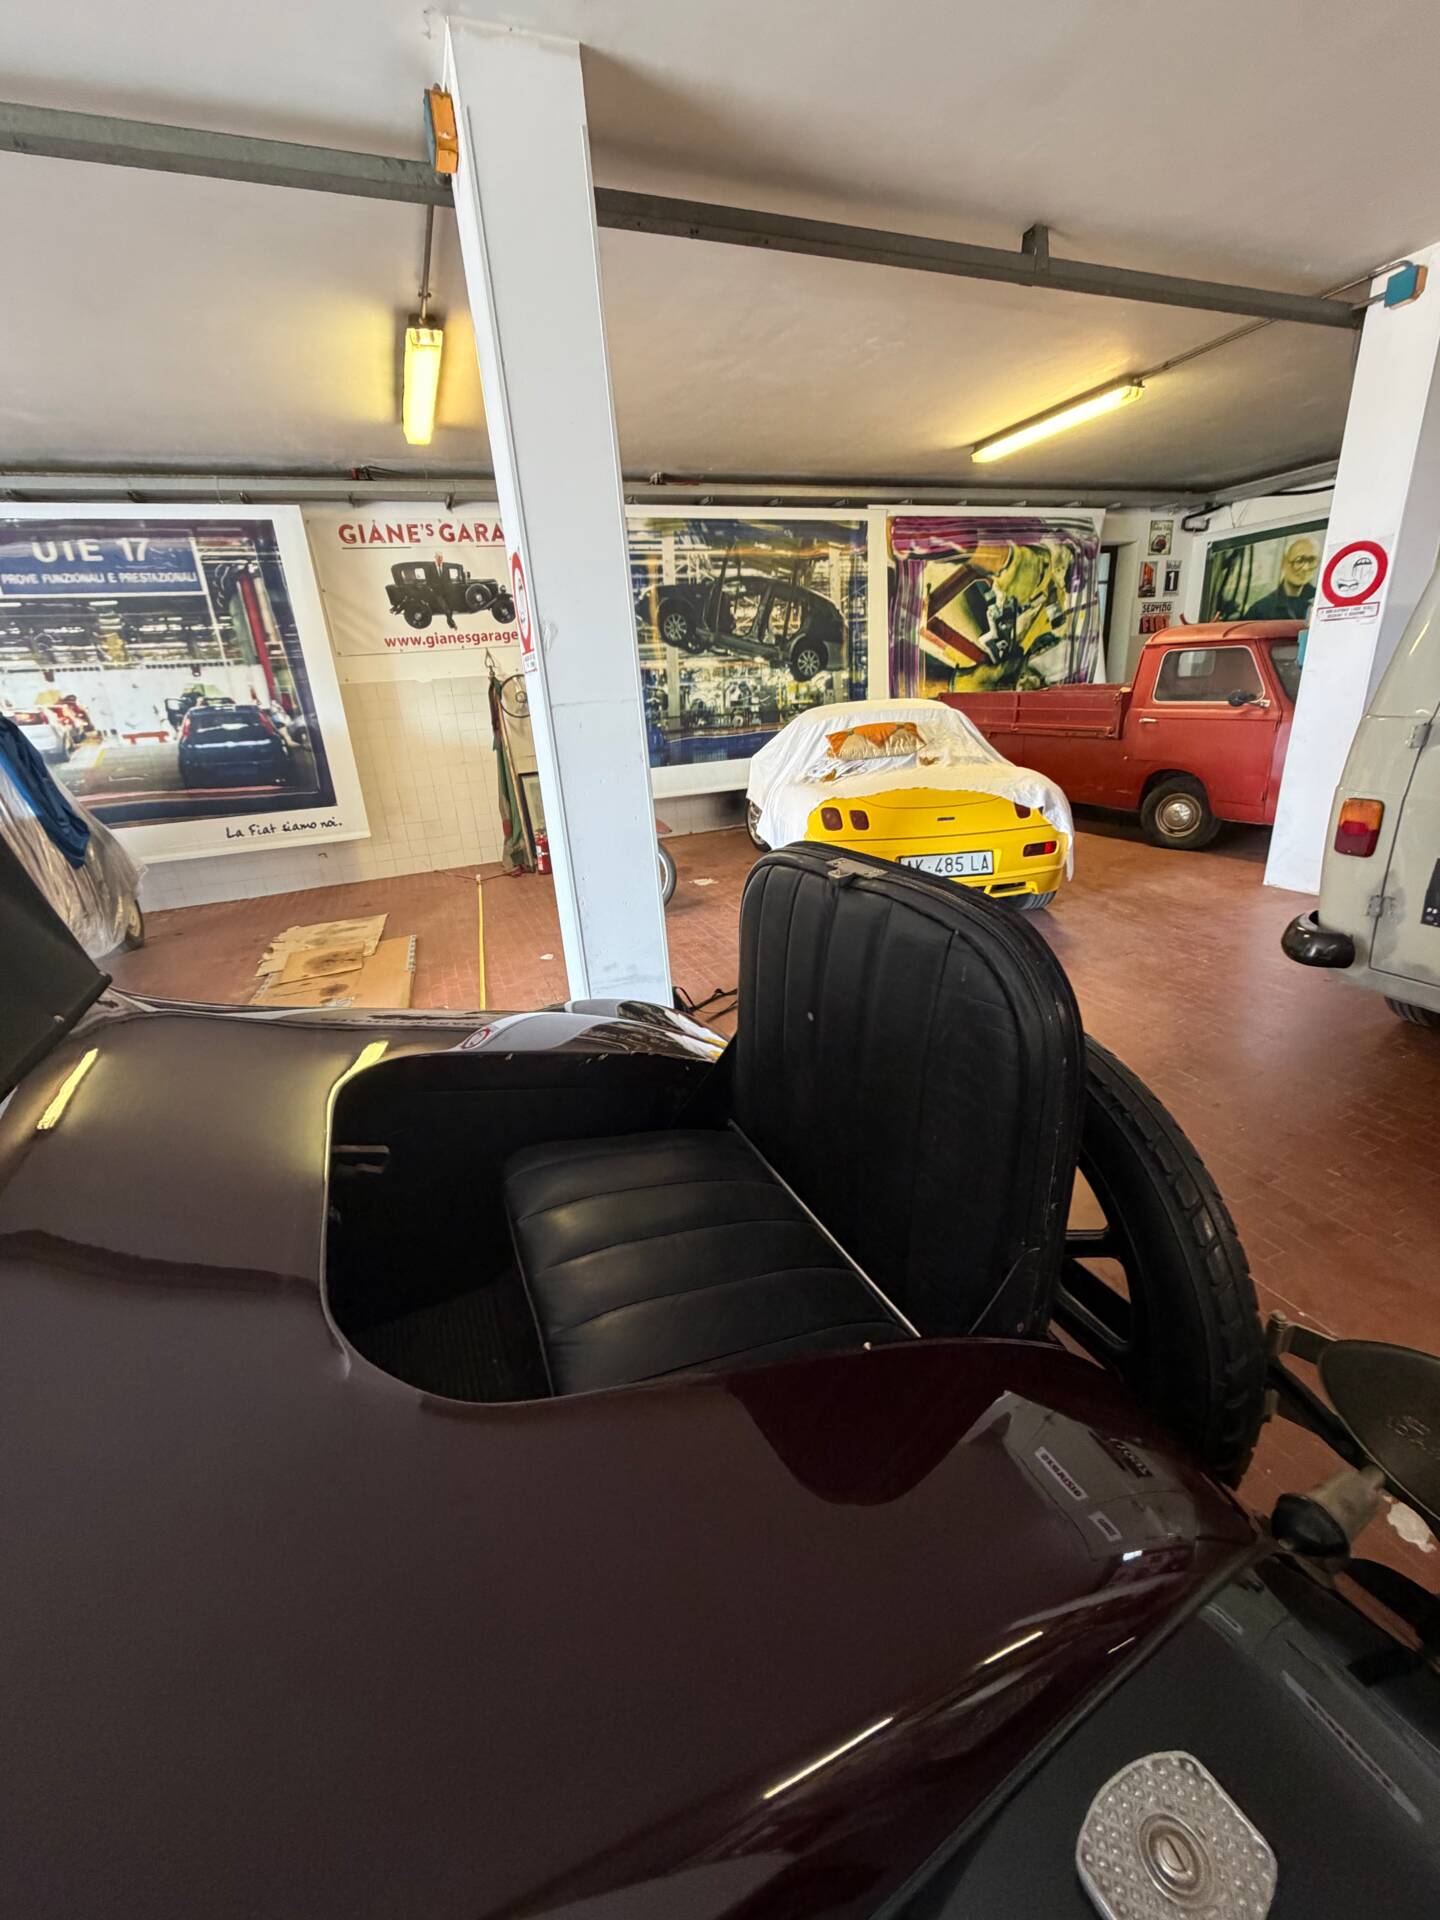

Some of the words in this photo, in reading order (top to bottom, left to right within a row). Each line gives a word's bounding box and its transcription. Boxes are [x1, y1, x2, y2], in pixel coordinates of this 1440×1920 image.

[438, 523, 504, 543] GARA
[117, 537, 149, 561] 17
[1, 573, 39, 584] PROVE
[41, 572, 105, 584] FUNZIONALI
[107, 572, 117, 583] E
[118, 571, 197, 583] PRESTAZIONALI
[384, 630, 518, 648] www.gianesgarage
[226, 827, 244, 838] La
[248, 823, 276, 836] Fiat
[281, 821, 317, 832] siamo
[934, 856, 964, 873] 485
[970, 854, 989, 871] LA
